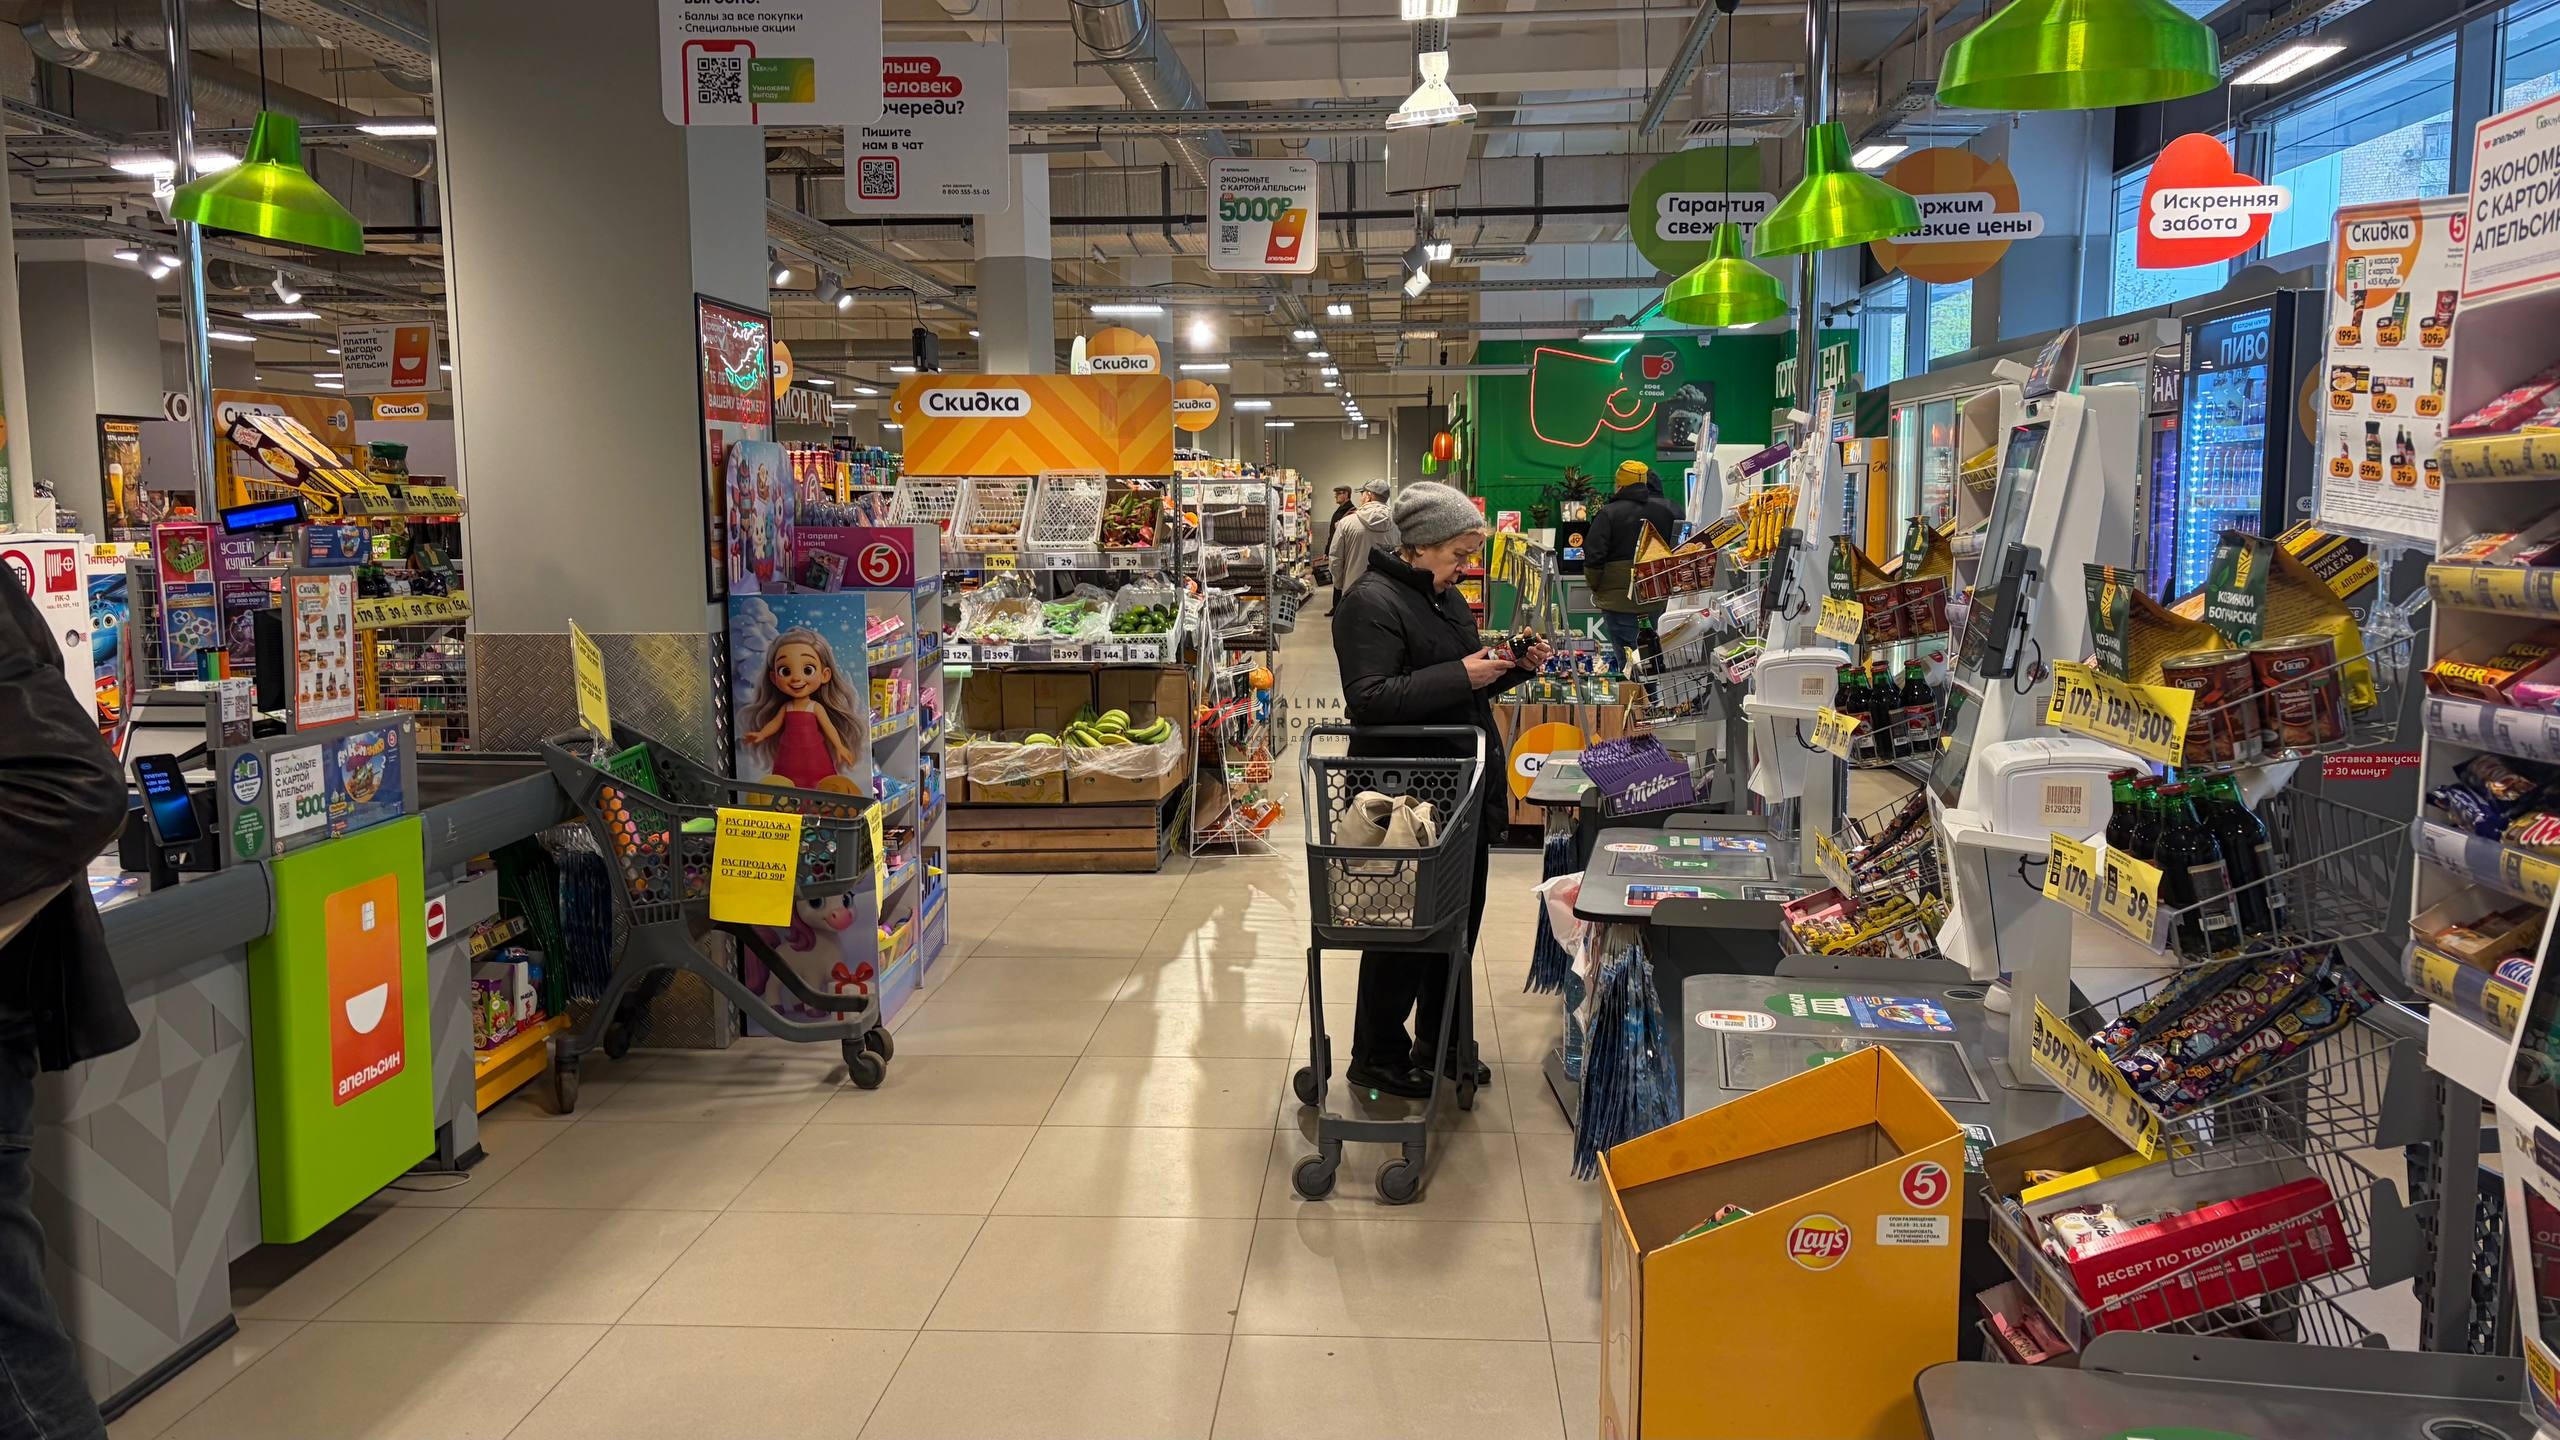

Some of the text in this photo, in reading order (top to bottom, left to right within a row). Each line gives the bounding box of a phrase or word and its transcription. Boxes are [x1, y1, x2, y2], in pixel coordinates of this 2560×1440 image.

[684, 12, 804, 24] Баллы за все покупки
[685, 23, 797, 34] Специальные акции
[883, 61, 932, 75] льше
[862, 127, 912, 138] Пишите
[862, 141, 924, 151] нам в чат
[1220, 176, 1270, 184] ЭКОНОМЬТЕ
[1228, 184, 1260, 192] КАРТОЙ
[2163, 193, 2279, 212] Искренняя
[2476, 170, 2560, 222] С КАРТОЙ
[1668, 197, 1765, 215] Гарантия
[1918, 199, 1984, 218] ержим
[1977, 219, 2033, 238] цены
[2162, 214, 2238, 232] забота
[2352, 221, 2409, 243] Скидка
[343, 337, 378, 345] ПЛАТИТЕ
[344, 346, 383, 354] ВЫГОДНО
[2220, 332, 2269, 367] ПИВО
[344, 353, 376, 361] КАРТОЙ
[1092, 354, 1151, 372] Скидка
[346, 362, 389, 370] АПЕЛЬСИН
[928, 391, 1020, 412] Скидка
[1173, 399, 1212, 411] Скидка
[381, 405, 420, 415] Скидка
[372, 494, 389, 507] 179
[995, 558, 1011, 568] 199
[1061, 558, 1072, 567] 29
[1126, 558, 1137, 567] 29
[952, 651, 968, 660] 129
[991, 651, 1009, 661] 399
[1061, 650, 1079, 660] 399
[1103, 651, 1119, 660] 144
[1143, 651, 1155, 661] 36
[2434, 660, 2490, 685] MELLER
[2068, 686, 2092, 717] 179
[2106, 695, 2131, 731] 154
[2138, 708, 2173, 746] 309
[2322, 753, 2421, 767] Доставка закуски
[274, 758, 317, 777] ЭКОНОМЬТЕ
[2335, 767, 2348, 776] 30
[2350, 766, 2387, 779] минут
[1624, 771, 1679, 805] Milka
[725, 815, 792, 832] РАСПРОДАЖА
[725, 827, 738, 838] ОТ
[759, 829, 772, 841] ДО
[720, 856, 788, 872] РАСПРОДАЖА
[721, 867, 734, 878] ОТ
[755, 870, 768, 881] ДО
[2064, 862, 2088, 897] 179
[2127, 885, 2150, 922] 39
[338, 1050, 401, 1097] апельсин
[1793, 1228, 1848, 1257] Lay's
[2096, 1259, 2153, 1289] ДЕСЕРТ
[2155, 1253, 2180, 1270] ПО
[2182, 1237, 2238, 1260] ТВОИМ
